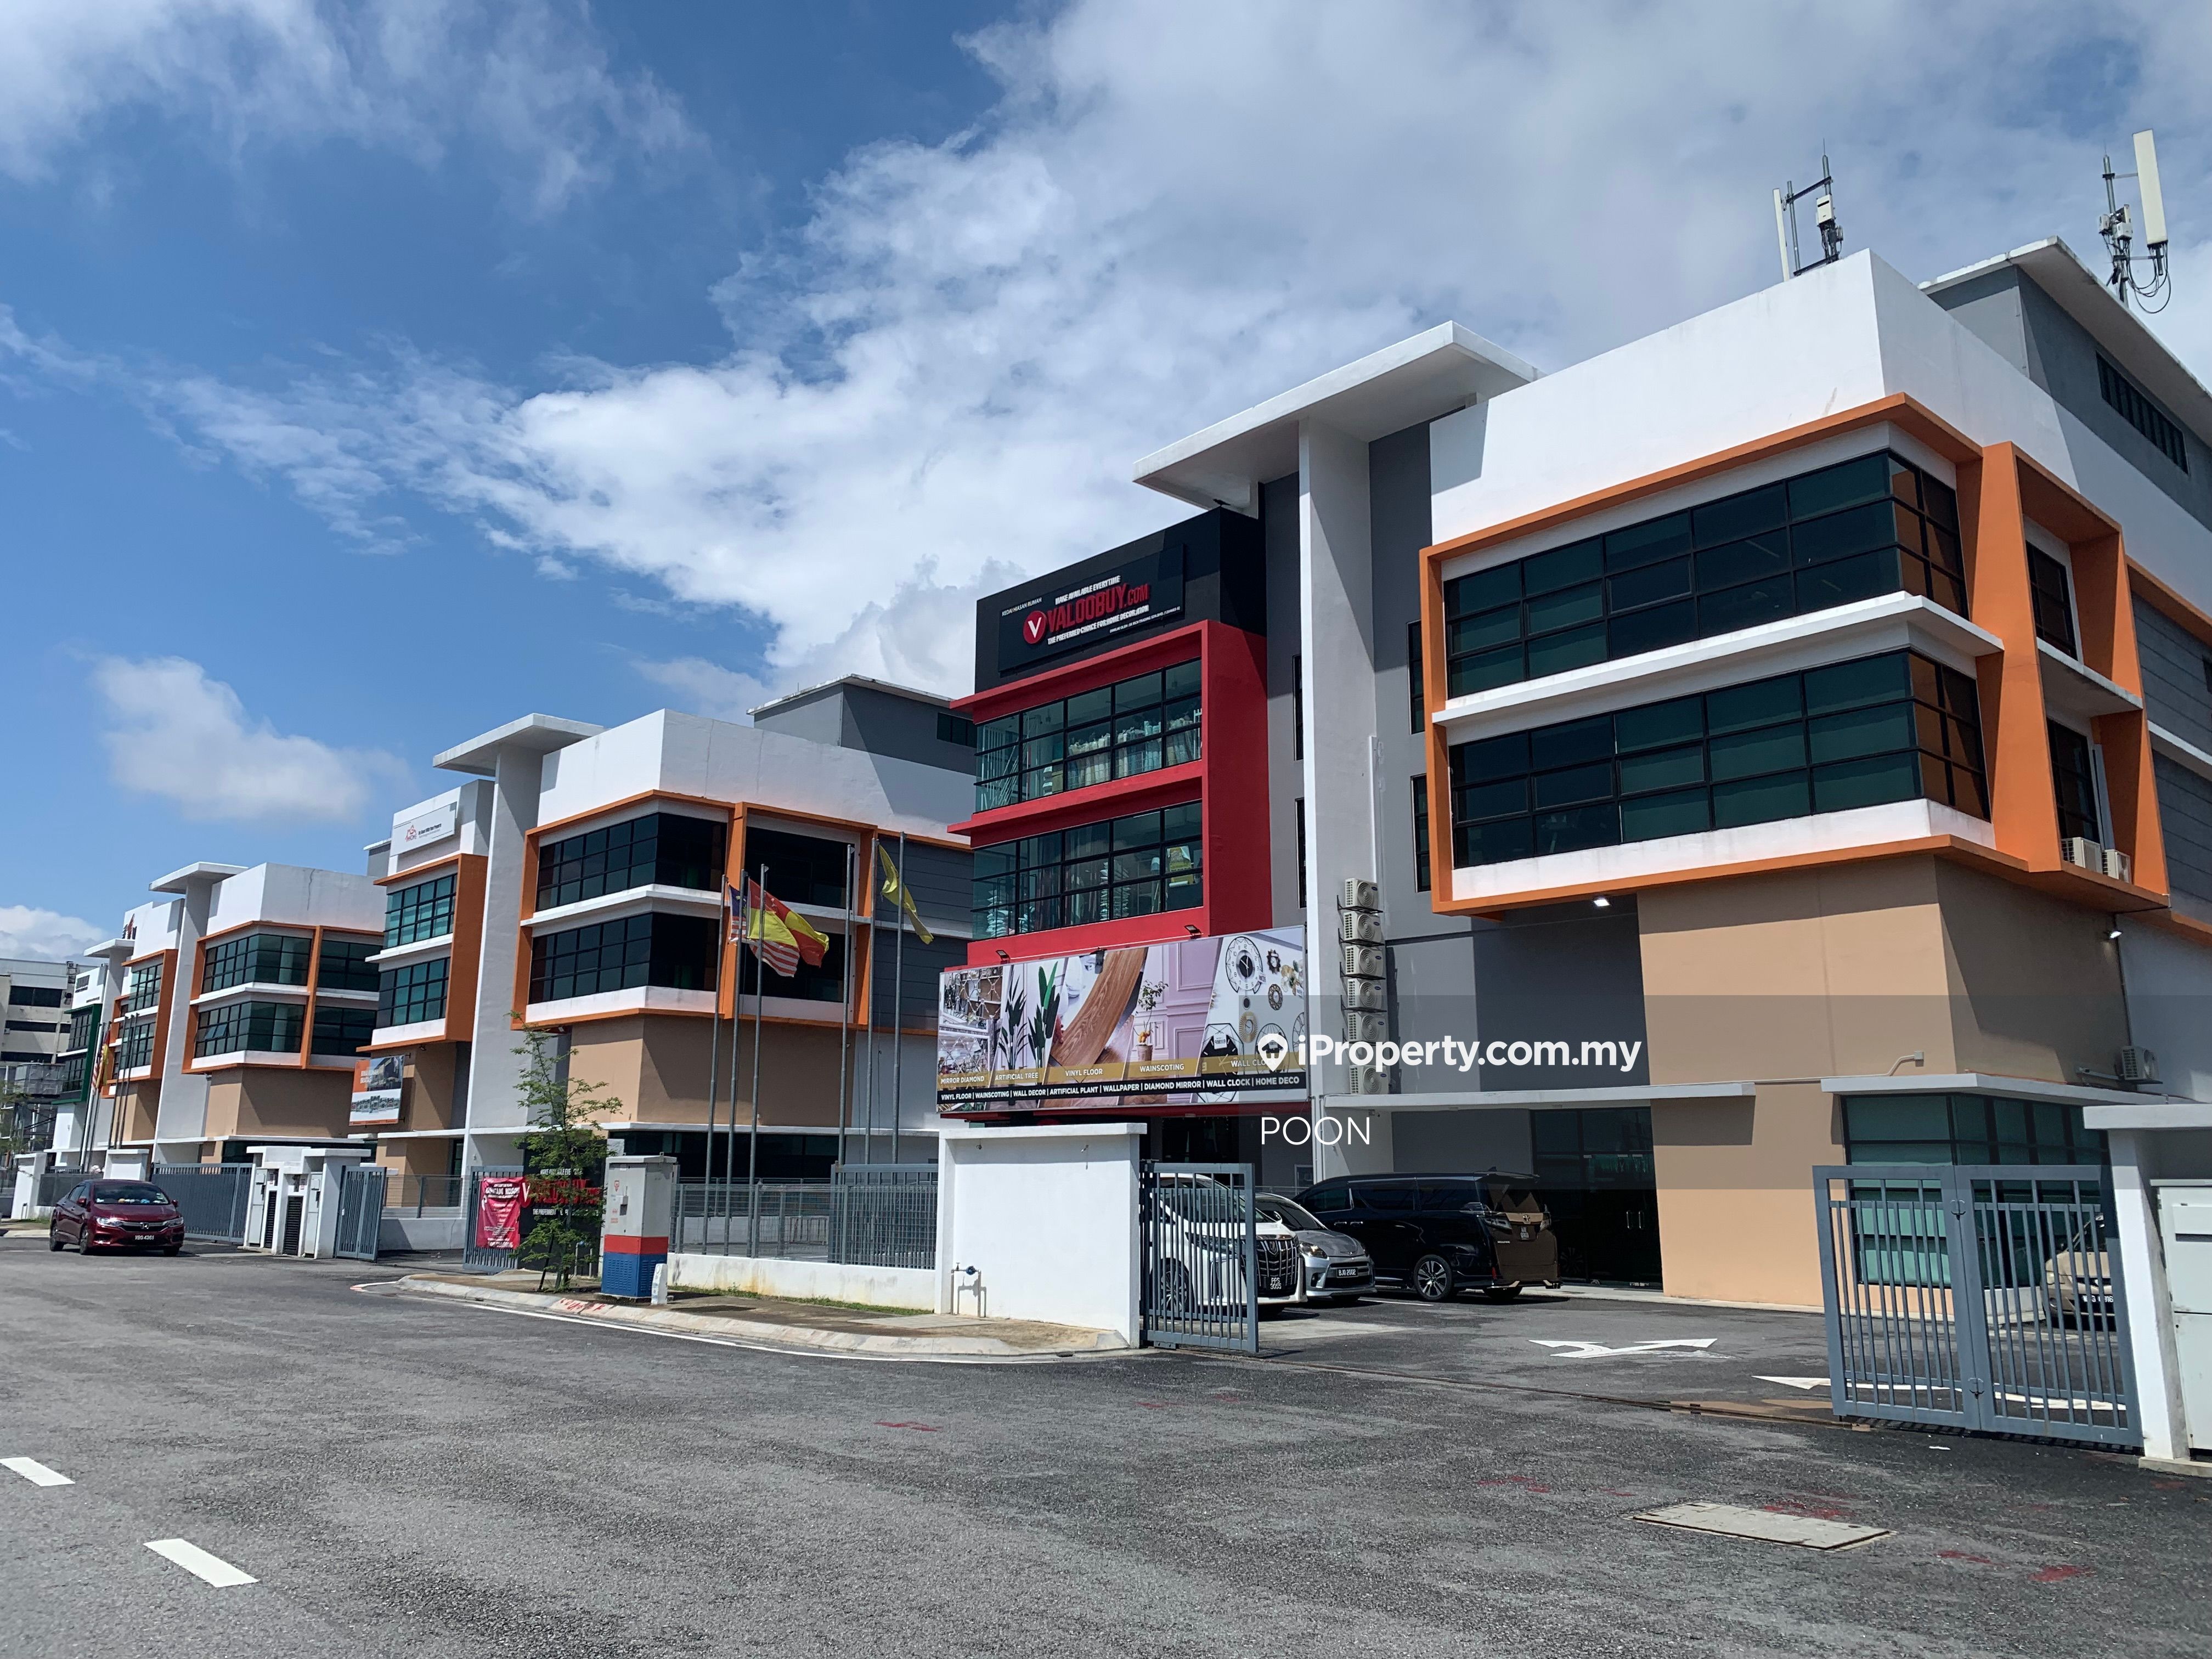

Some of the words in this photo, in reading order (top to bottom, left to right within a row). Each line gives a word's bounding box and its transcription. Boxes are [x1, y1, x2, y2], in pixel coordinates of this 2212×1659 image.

[1055, 595, 1069, 605] MAKE
[1068, 585, 1093, 600] AVAILABLE
[1093, 575, 1121, 591] EVERYTIME
[1002, 608, 1013, 617] KEDAI
[1013, 602, 1027, 612] HIASAN
[1027, 597, 1042, 607] RUMAH
[1028, 617, 1042, 639] V
[1047, 636, 1057, 645] THE
[1056, 628, 1081, 642] PREFERRED
[1080, 622, 1097, 634] CHOICE
[1097, 619, 1106, 629] FOR
[1105, 614, 1120, 625] HOME
[1120, 604, 1149, 621] DECORATION
[1139, 1064, 1184, 1073] WAINSCOTING
[1231, 1059, 1251, 1068] WALL
[1103, 1084, 1139, 1092] WALLPAPER
[1144, 1082, 1175, 1091] DIAMOND
[1176, 1081, 1201, 1089] MIRROR
[1206, 1079, 1226, 1087] WALL
[1227, 1078, 1251, 1086] CLOCK
[1255, 1077, 1278, 1086] HOME
